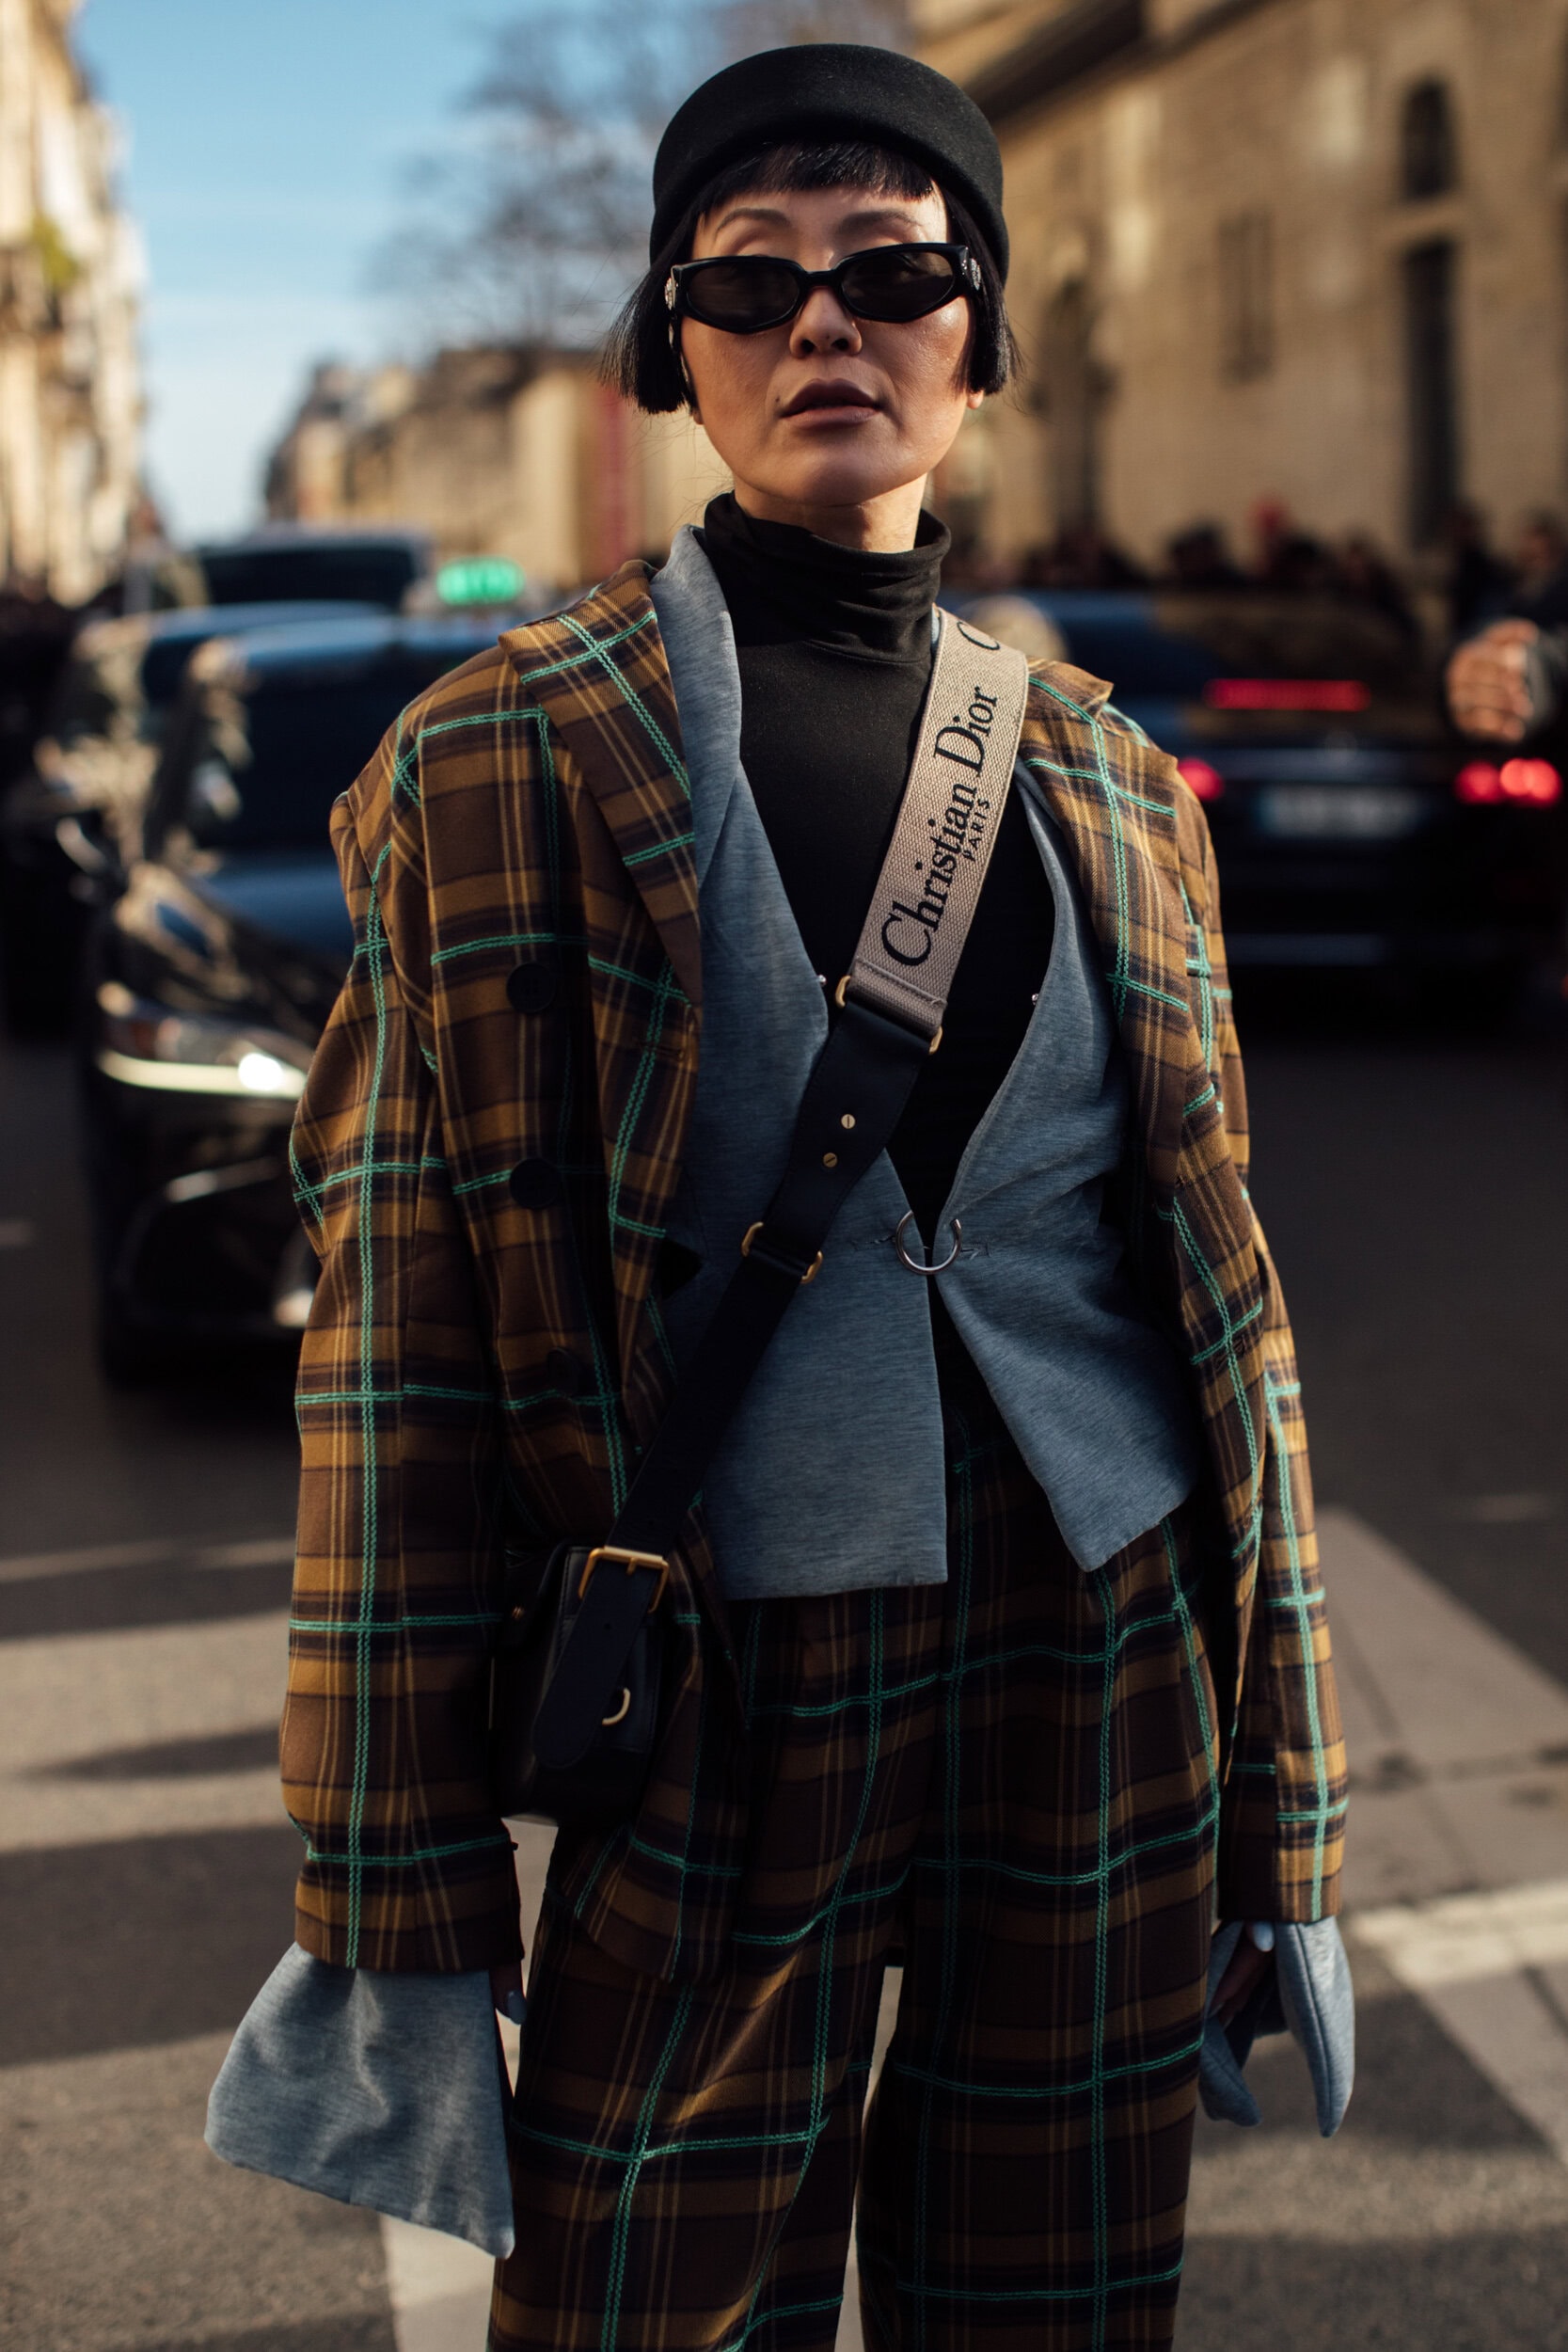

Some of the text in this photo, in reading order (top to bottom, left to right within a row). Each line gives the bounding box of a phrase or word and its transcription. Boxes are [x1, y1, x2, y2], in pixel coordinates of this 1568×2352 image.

[881, 686, 998, 966] Christian Dior
[961, 798, 990, 862] PARIS
